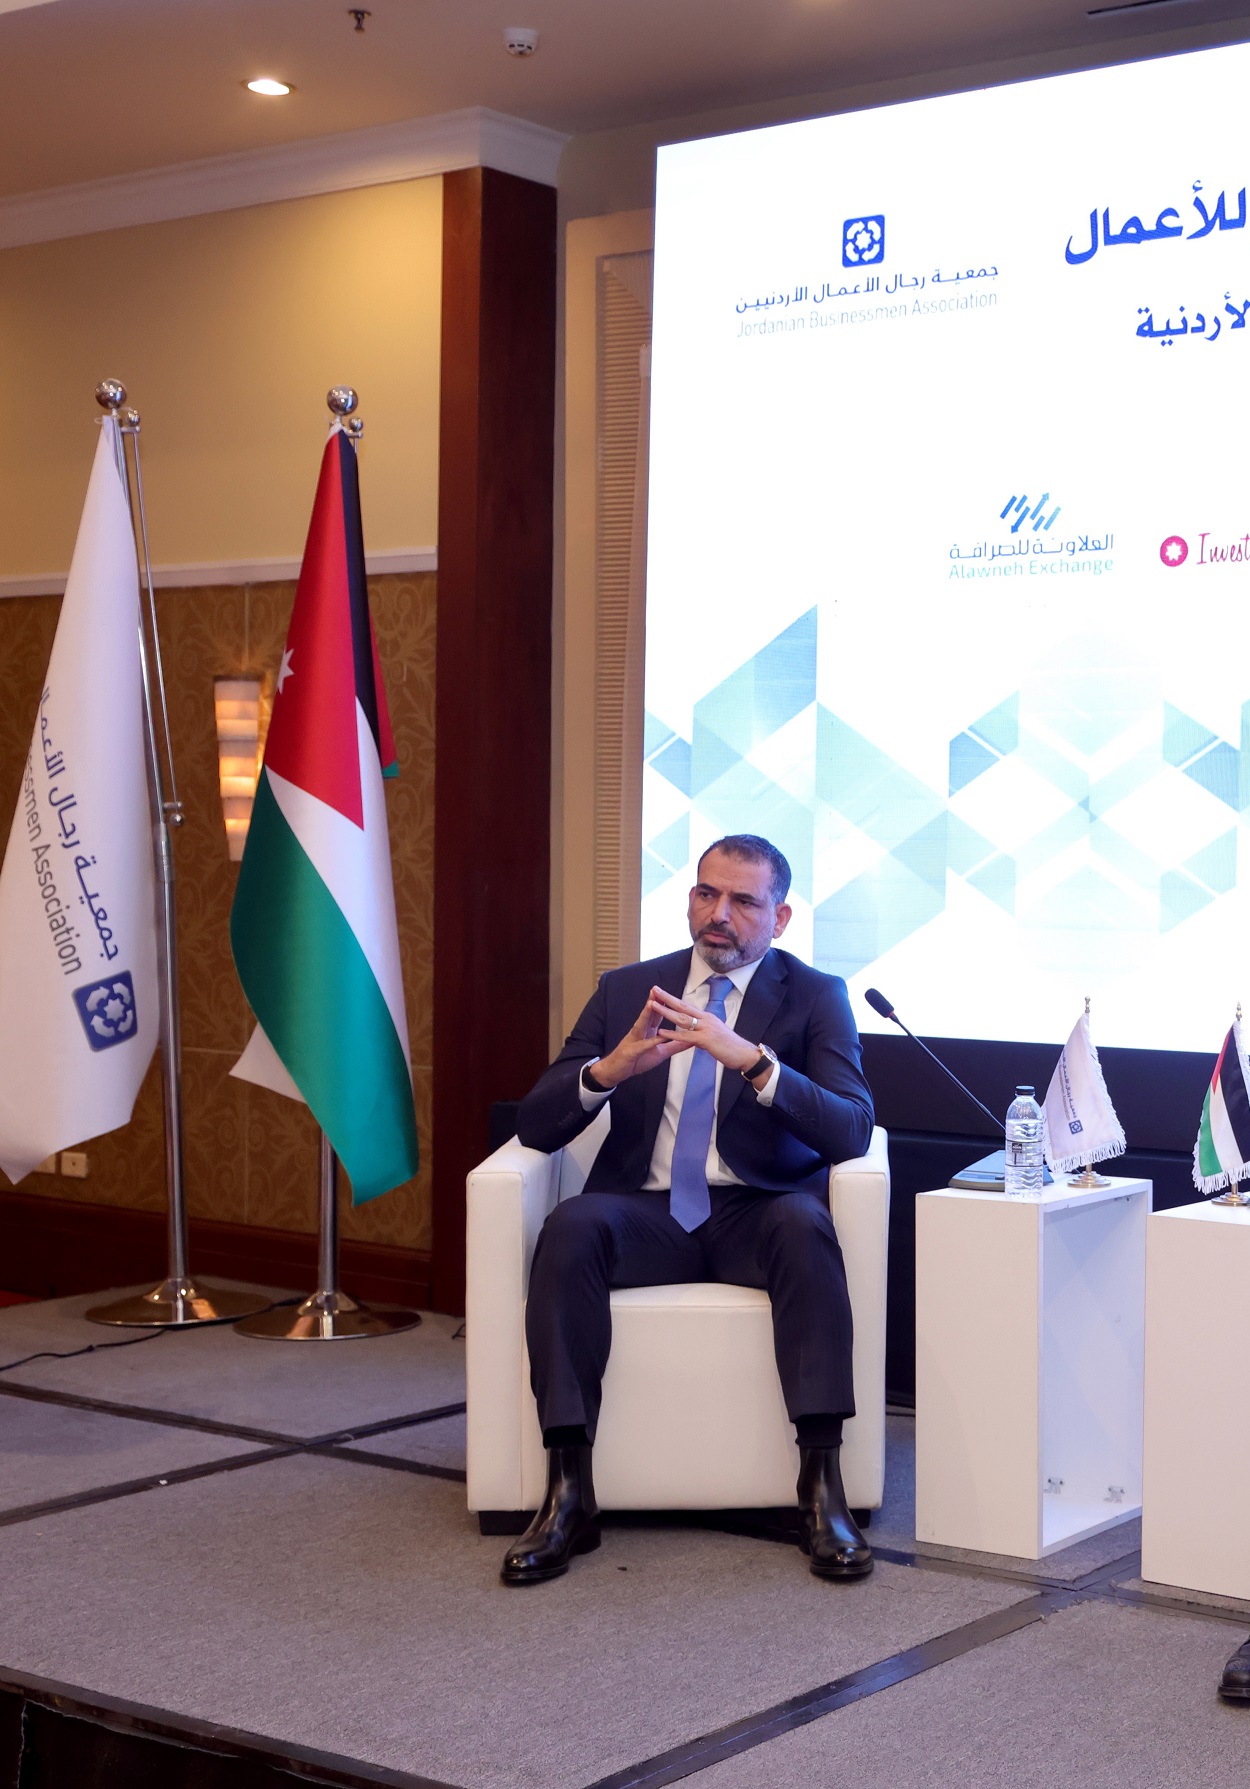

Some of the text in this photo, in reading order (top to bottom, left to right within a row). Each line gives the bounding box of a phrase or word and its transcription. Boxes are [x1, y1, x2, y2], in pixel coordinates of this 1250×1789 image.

[1064, 180, 1247, 266] للأعمال
[735, 266, 998, 314] جمعية رجال الأعمال الأردنيين
[737, 289, 998, 338] Jordanian Businessmen Association
[949, 534, 1114, 562] العلاونة للصرافة
[949, 557, 1114, 580] Alawneh Exchange
[48, 785, 81, 849] رجال
[31, 843, 83, 976] Association
[74, 854, 119, 962] جمعية
